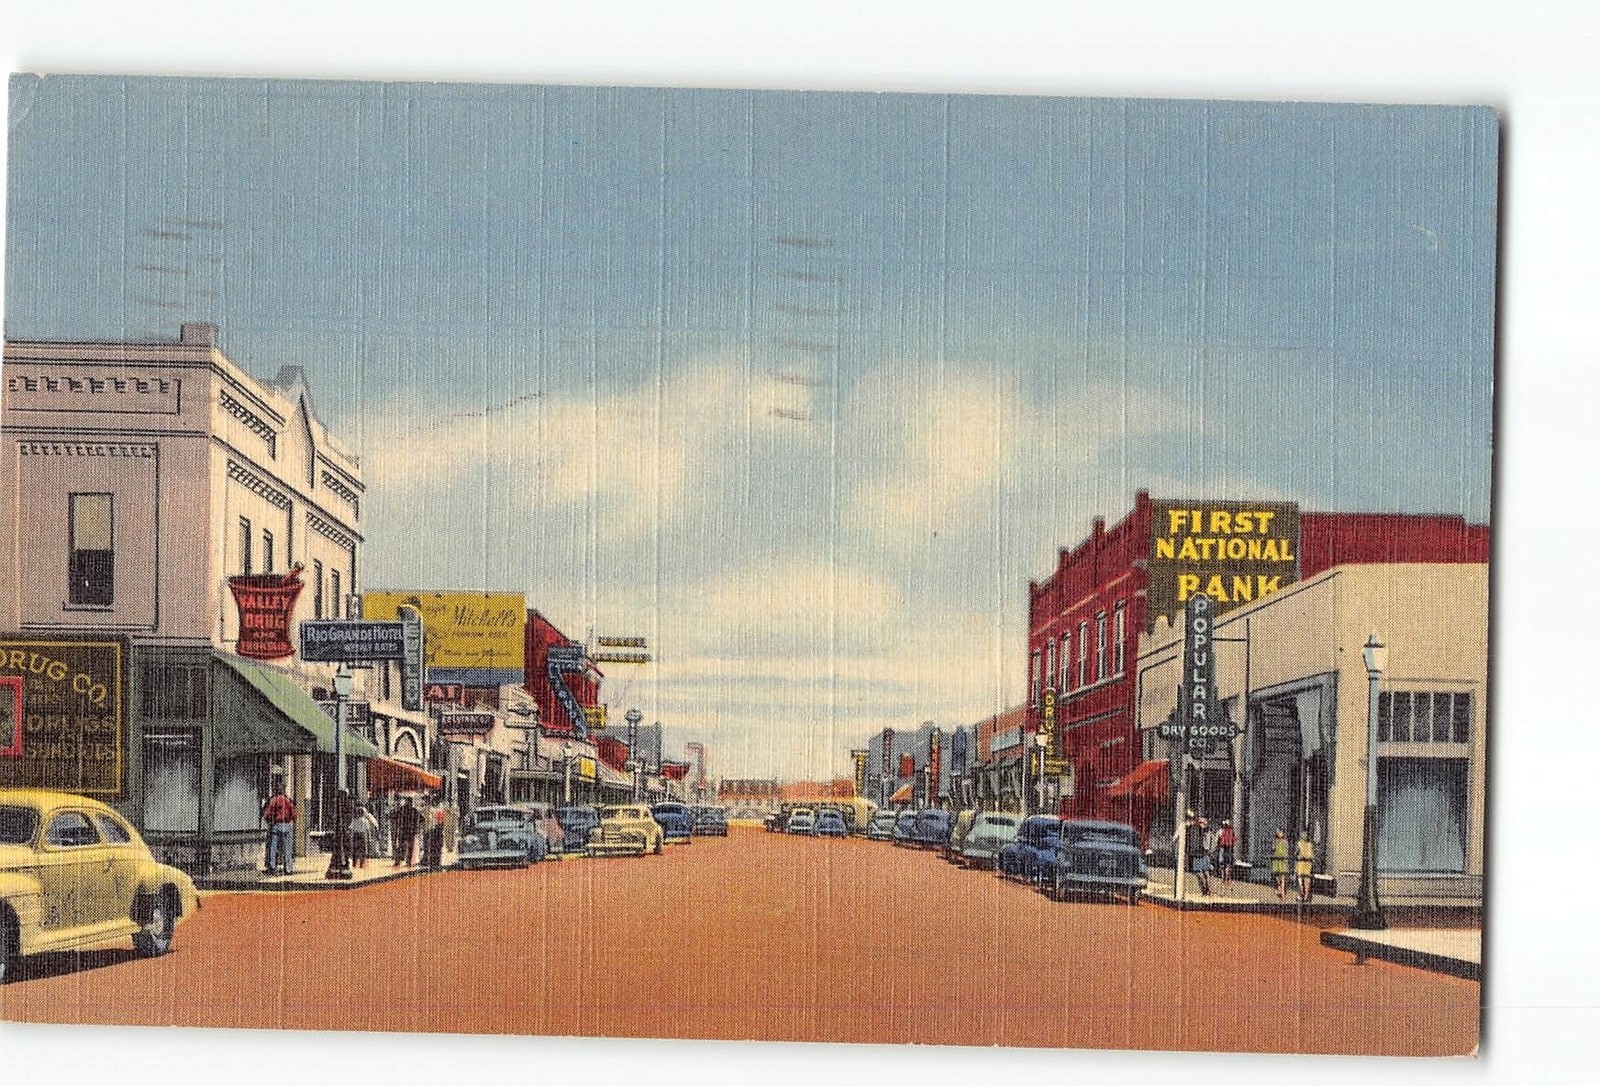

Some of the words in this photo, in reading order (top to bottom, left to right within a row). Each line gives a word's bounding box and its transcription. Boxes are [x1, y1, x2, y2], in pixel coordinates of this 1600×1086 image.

[1168, 510, 1274, 534] FIRST
[1156, 537, 1295, 561] NATIONAL
[239, 595, 290, 610] VALLEY
[245, 613, 285, 629] DRUG
[306, 626, 328, 641] RIO
[328, 626, 372, 641] GRANDE
[373, 626, 404, 640] HOTEL
[1193, 601, 1207, 719] POPULAR
[1161, 726, 1186, 736] DRY
[1190, 725, 1236, 737] GOODS
